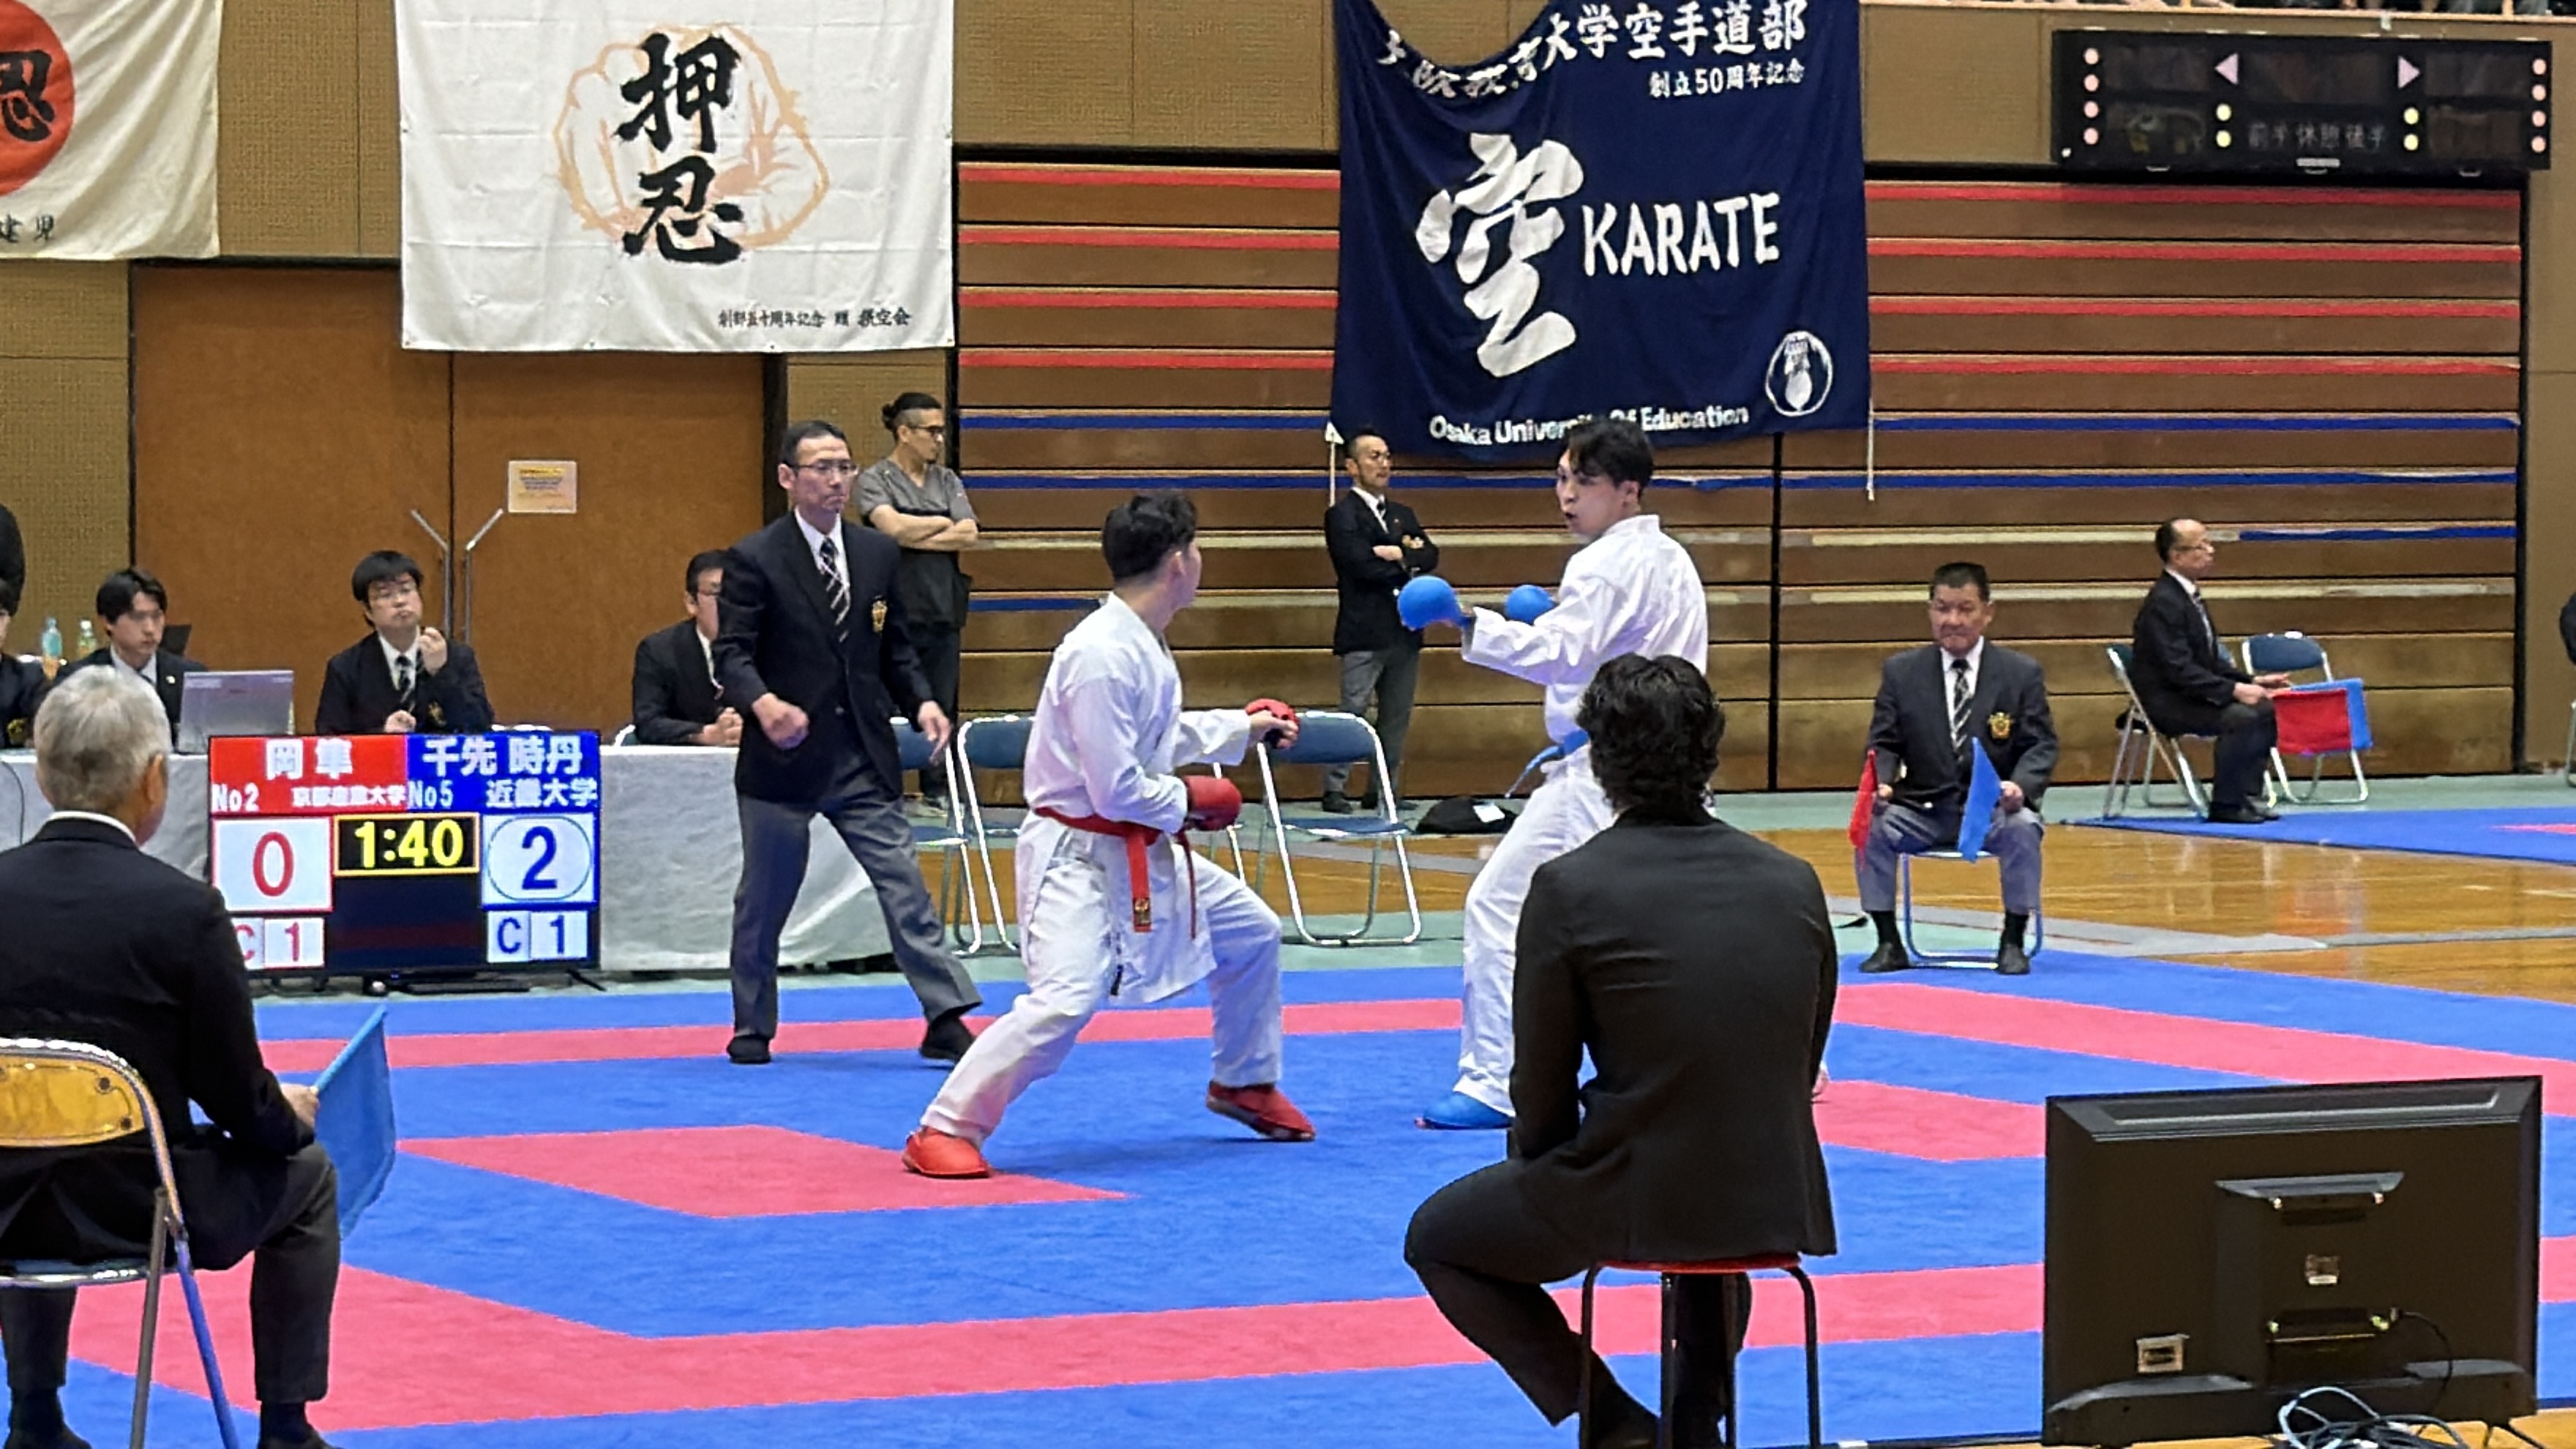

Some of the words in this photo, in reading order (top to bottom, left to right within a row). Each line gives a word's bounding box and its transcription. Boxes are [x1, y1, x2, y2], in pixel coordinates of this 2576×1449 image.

[1649, 58, 1805, 98] 創立50周年記念
[613, 33, 745, 264] 押忍
[1581, 192, 1781, 276] KARATE
[1430, 416, 1491, 445] Osaka
[1641, 405, 1749, 431] Education
[211, 782, 260, 812] No2
[408, 779, 454, 808] No5
[252, 831, 293, 897] 0
[355, 820, 464, 868] 1:40
[522, 826, 558, 891] 2
[284, 921, 300, 962] 1
[497, 918, 521, 954] C
[550, 916, 565, 954] 1
